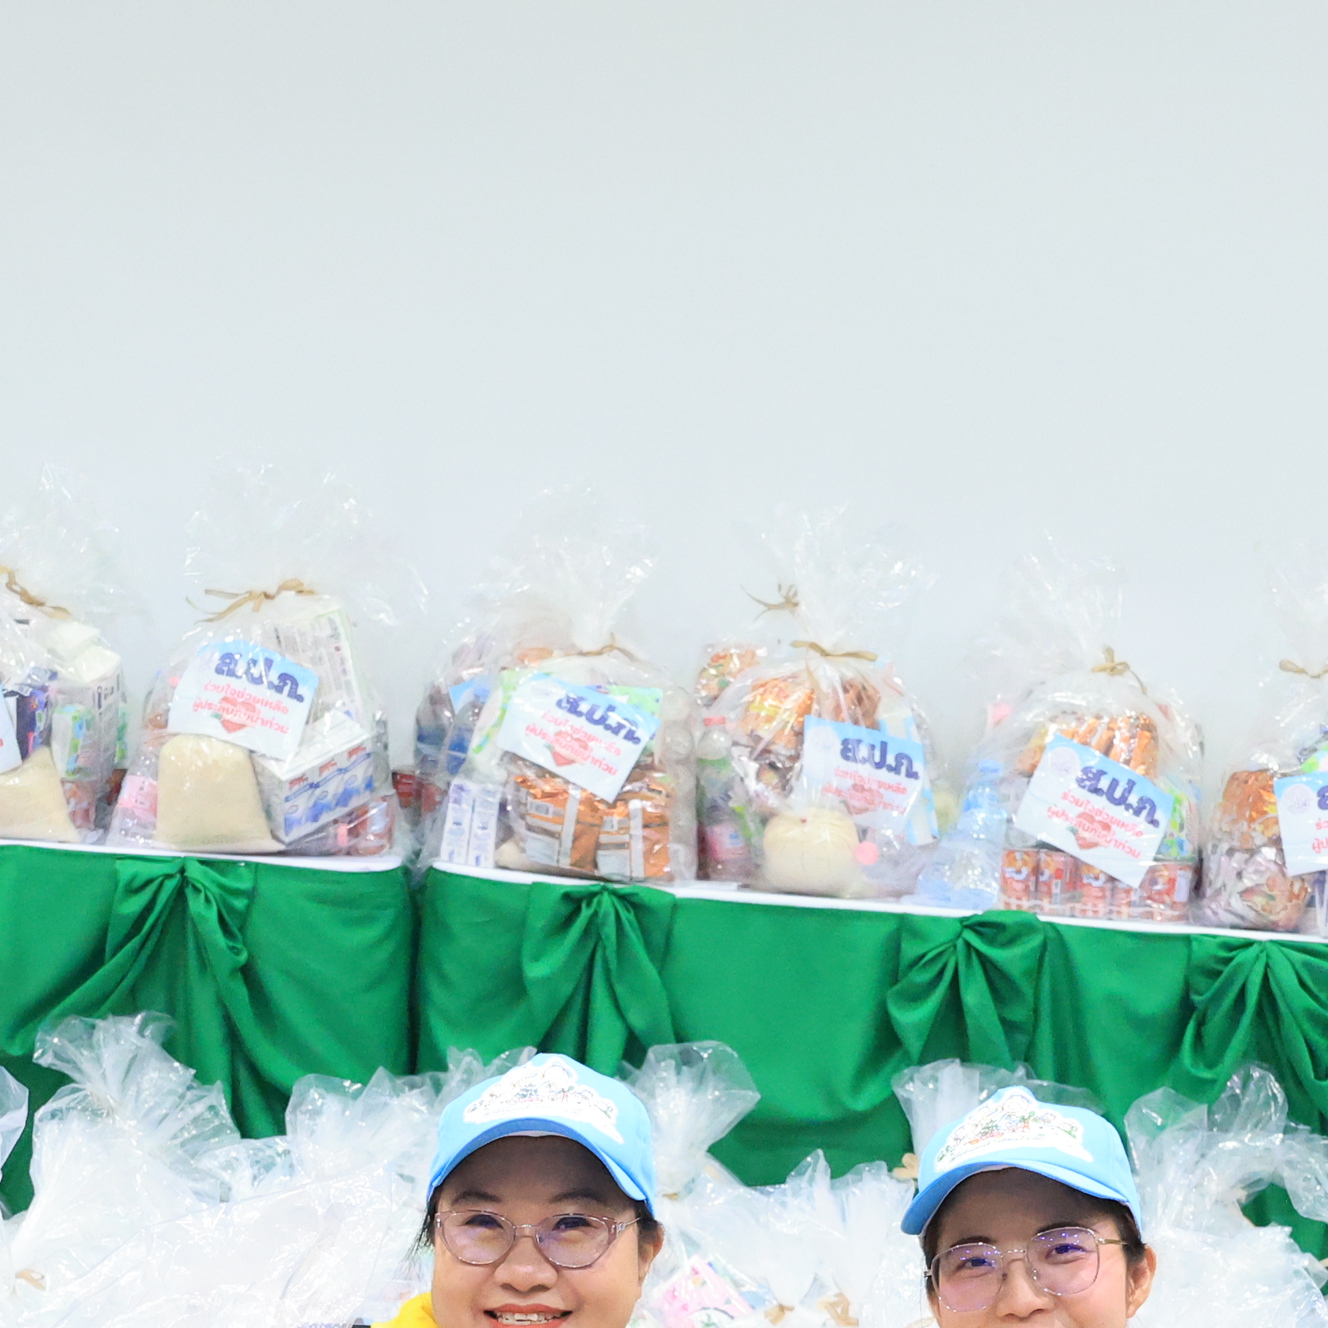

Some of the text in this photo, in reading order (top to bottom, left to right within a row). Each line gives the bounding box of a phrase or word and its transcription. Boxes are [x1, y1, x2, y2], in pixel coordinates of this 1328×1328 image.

[215, 652, 305, 704] ส.ป.ก.
[556, 693, 642, 746] ส.ป.ก.
[840, 738, 920, 780] ส.ป.ก.
[1075, 766, 1160, 828] ส.ป.ก.
